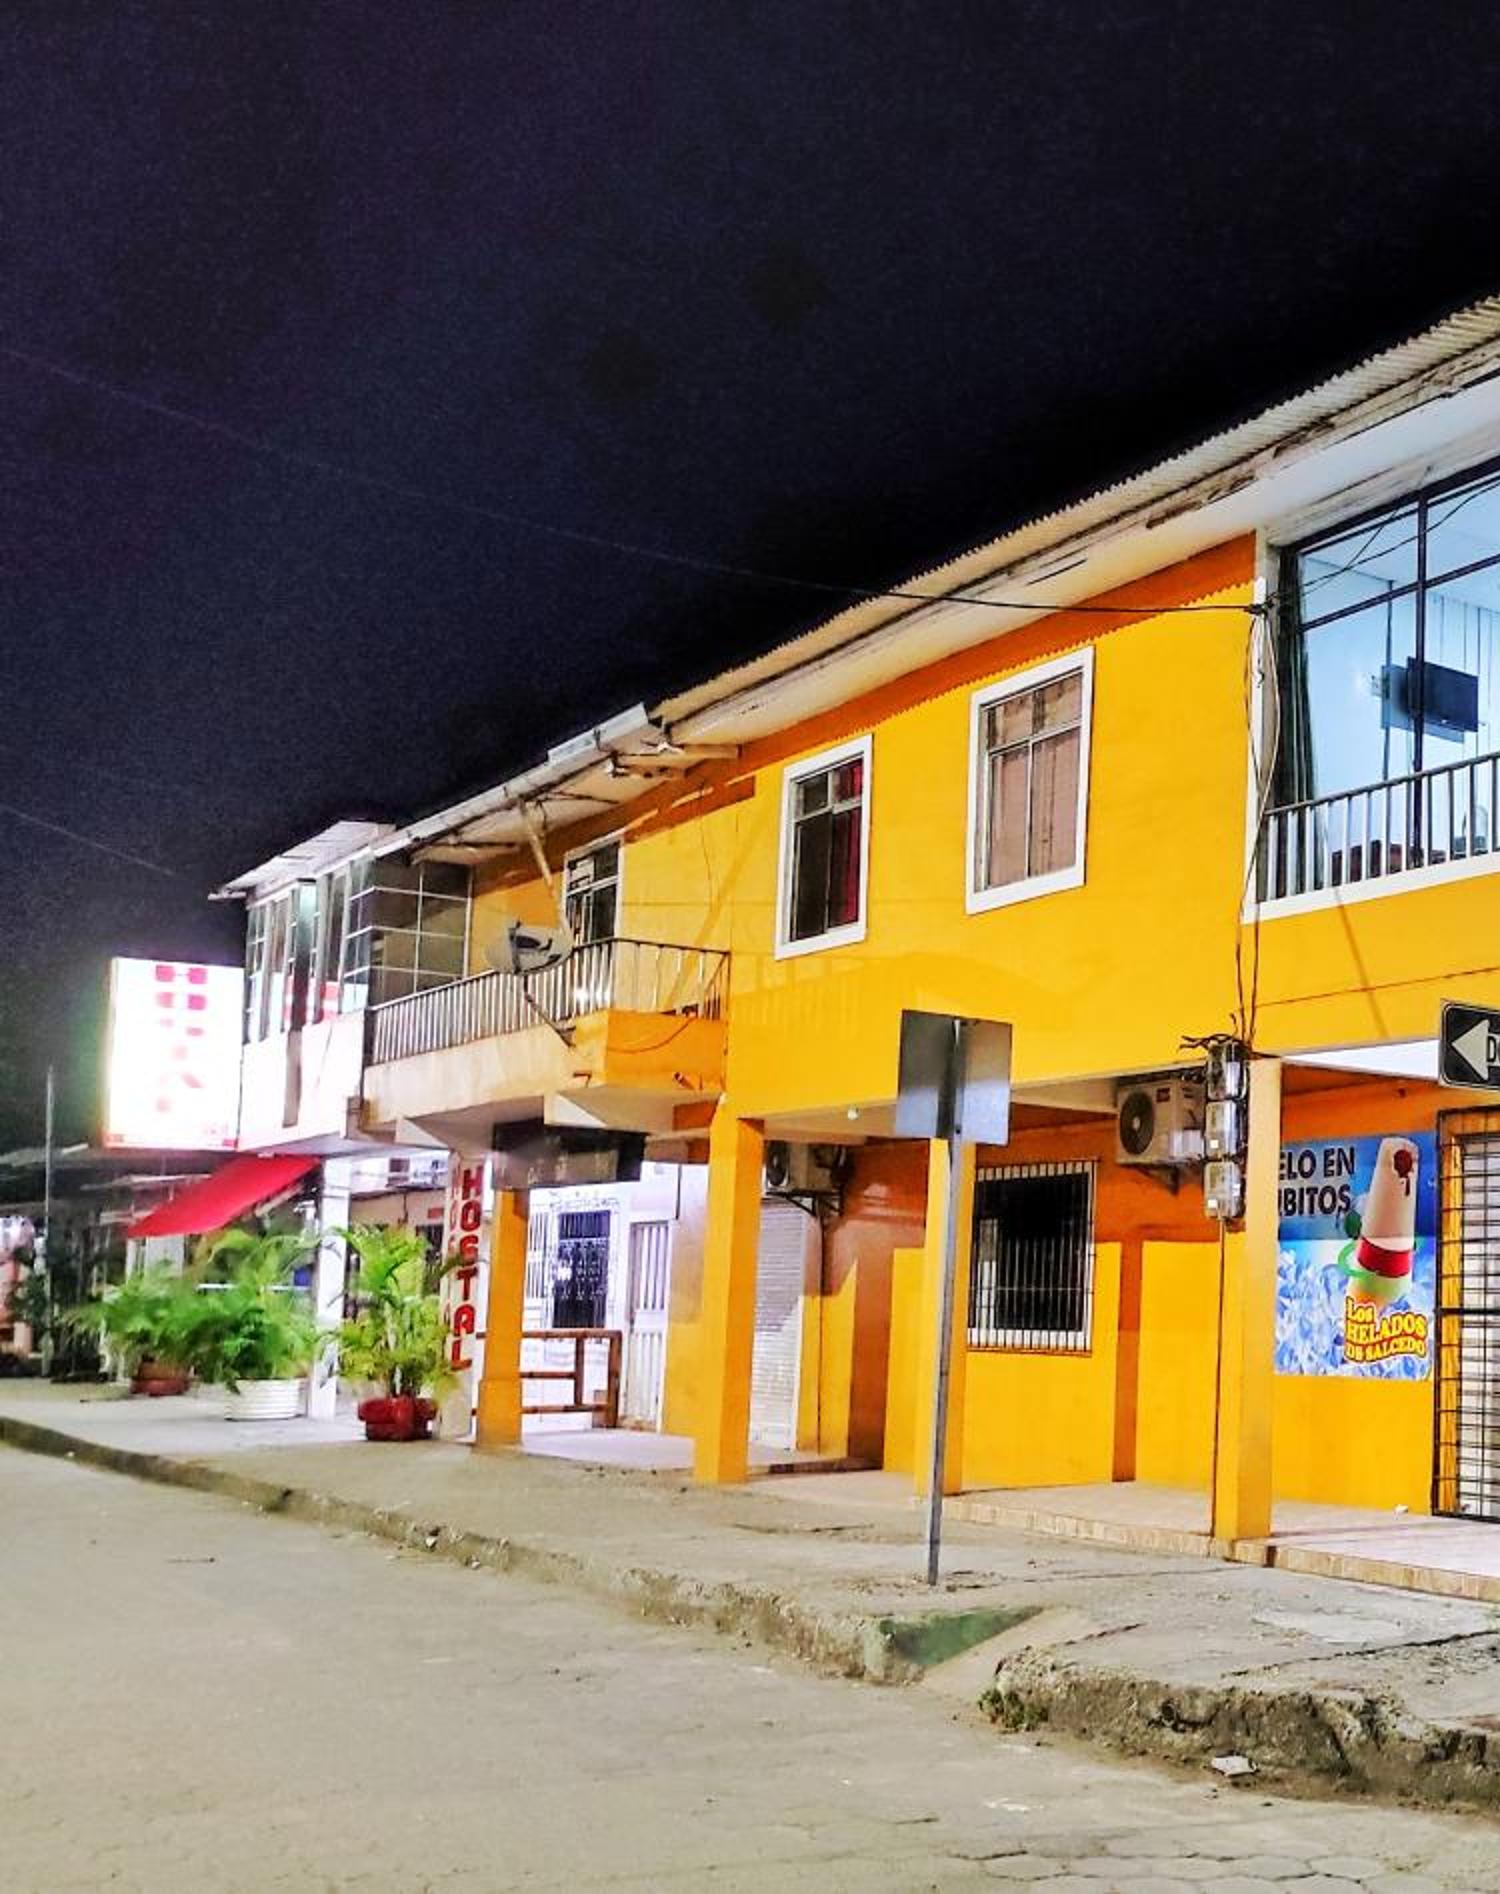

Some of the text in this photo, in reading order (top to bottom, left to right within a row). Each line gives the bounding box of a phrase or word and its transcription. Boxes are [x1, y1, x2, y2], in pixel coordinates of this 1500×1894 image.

[1323, 1146, 1355, 1178] EN
[1279, 1183, 1351, 1217] BITOS
[451, 1164, 484, 1371] HOSTAL
[1345, 1312, 1428, 1345] HELADOS
[1345, 1336, 1427, 1362] DE SALCEDO
